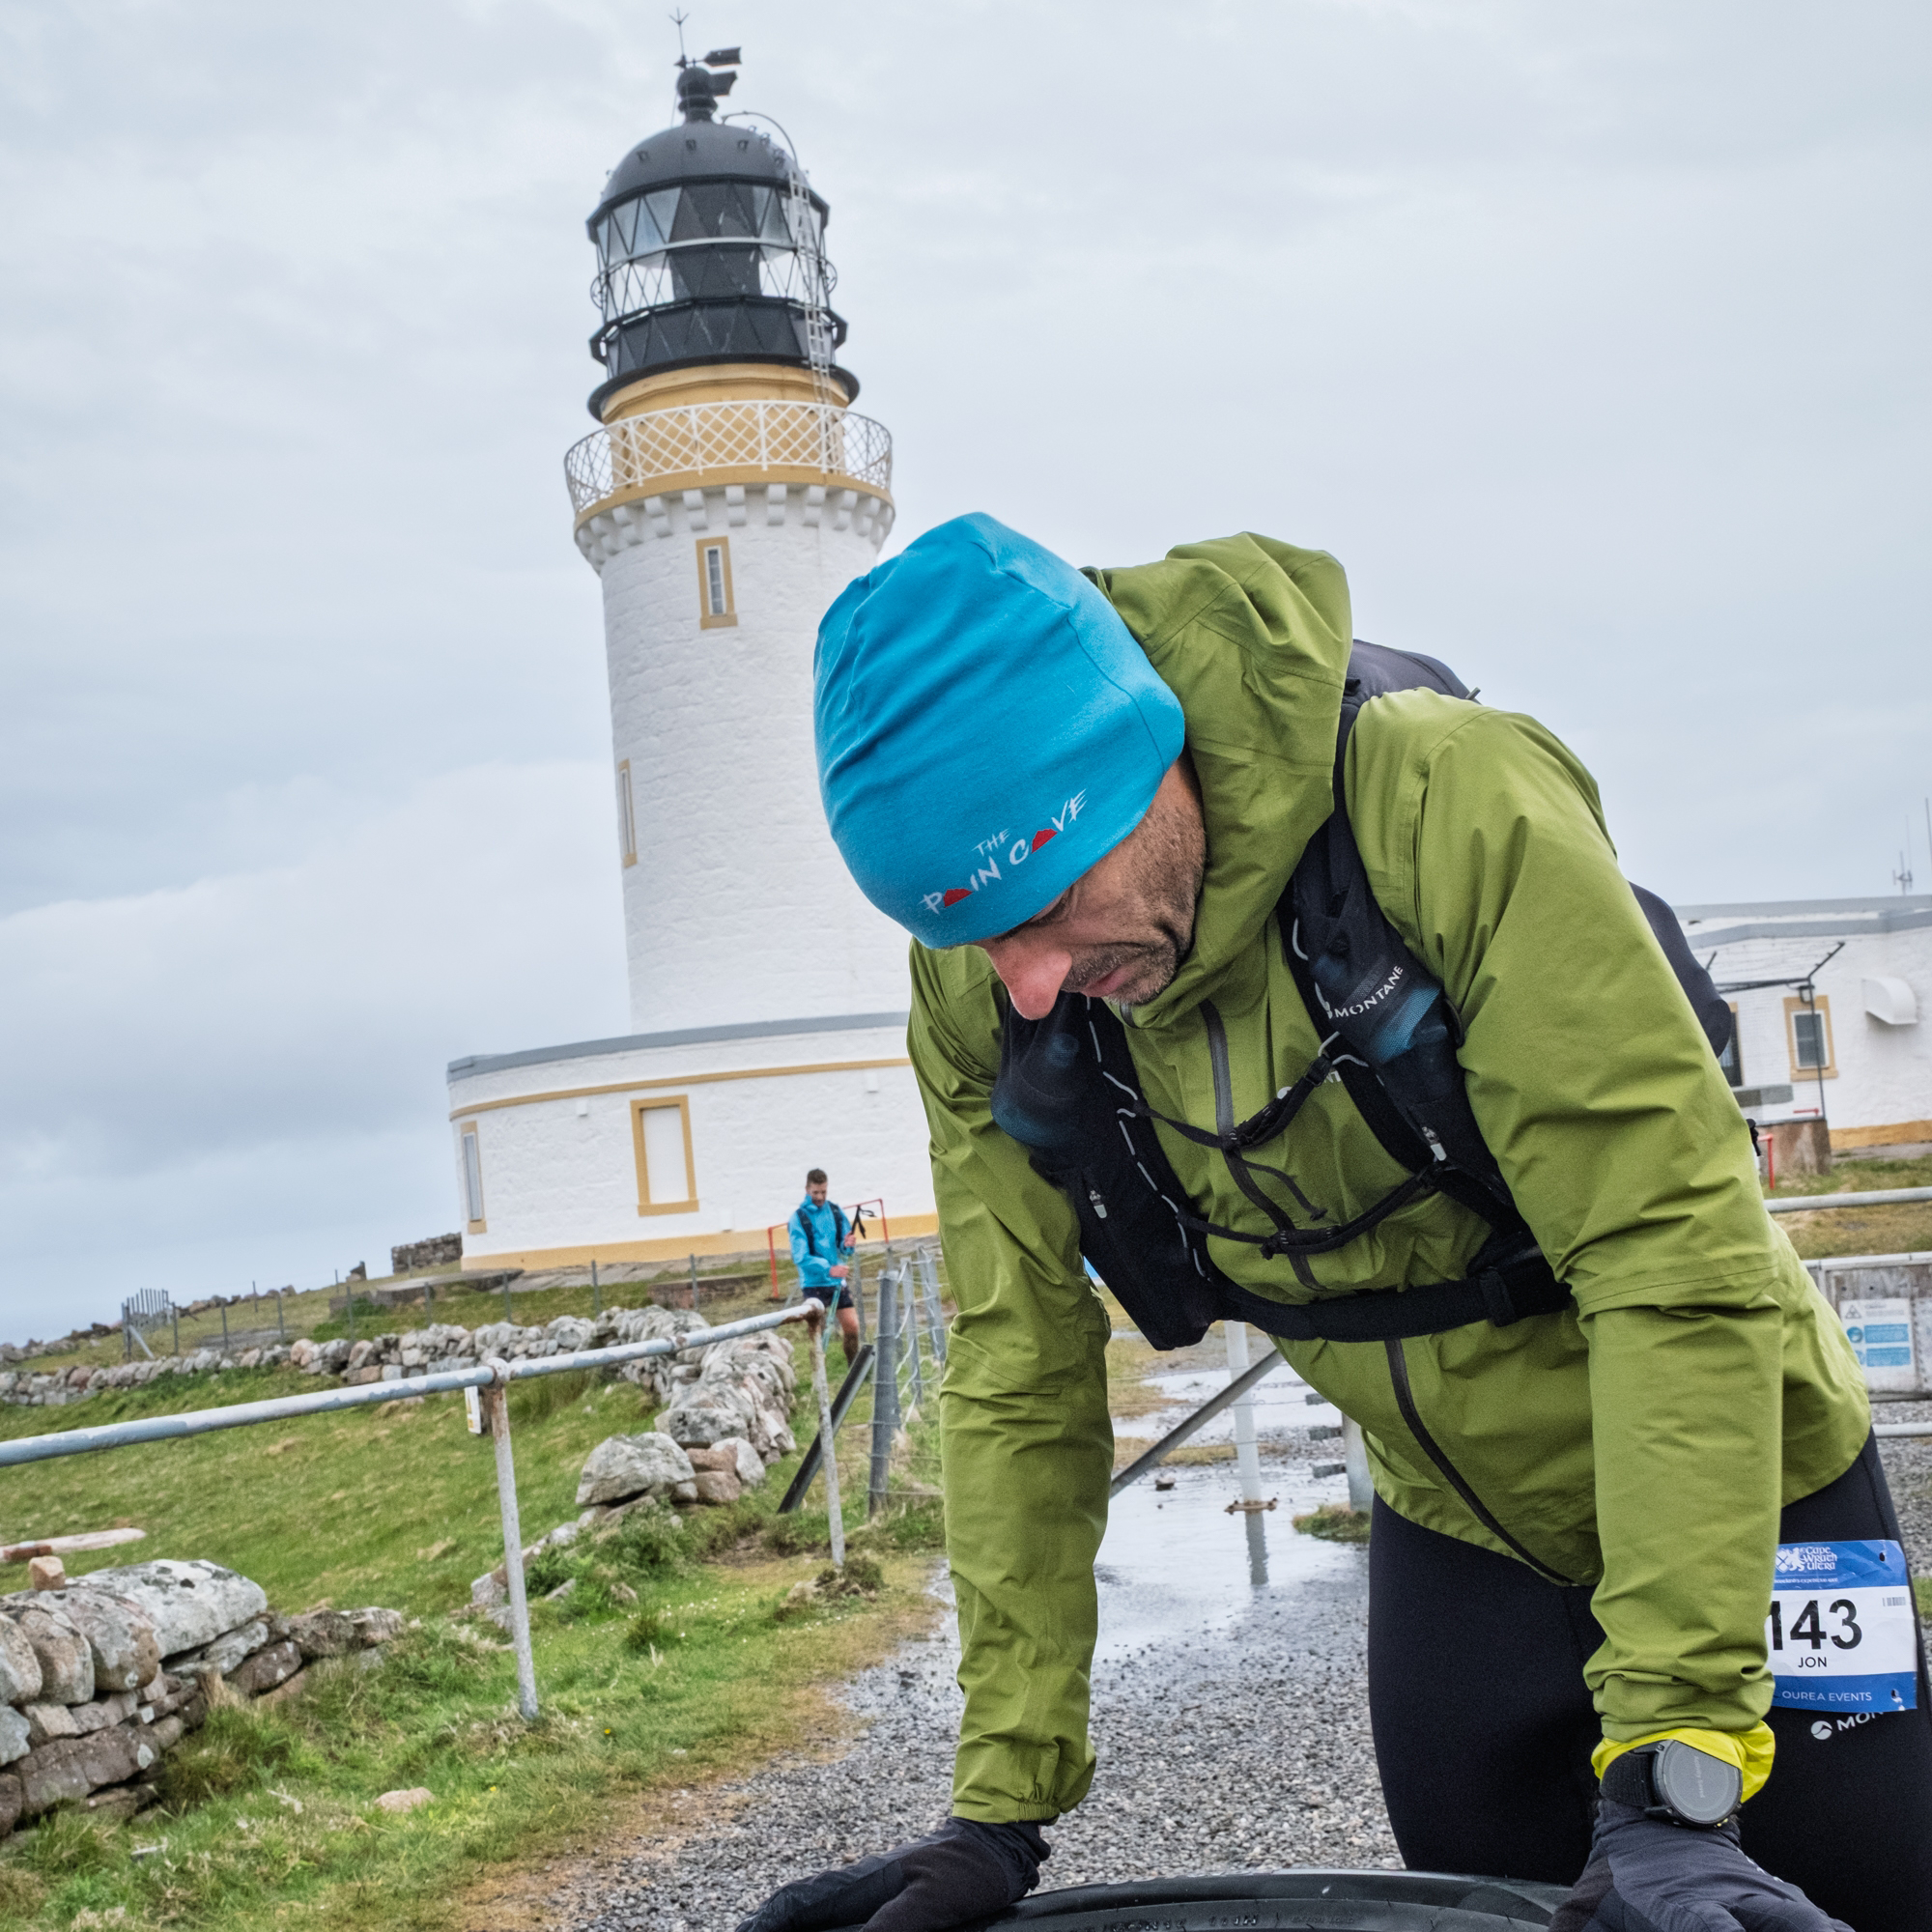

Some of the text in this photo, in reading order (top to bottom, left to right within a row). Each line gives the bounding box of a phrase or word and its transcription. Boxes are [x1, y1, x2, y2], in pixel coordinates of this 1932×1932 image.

[971, 828, 1010, 857] THE
[1333, 965, 1404, 1018] MONTANE
[1771, 1599, 1862, 1651] 143
[1798, 1656, 1828, 1668] JON
[1782, 1690, 1872, 1702] OUREA EVENTS
